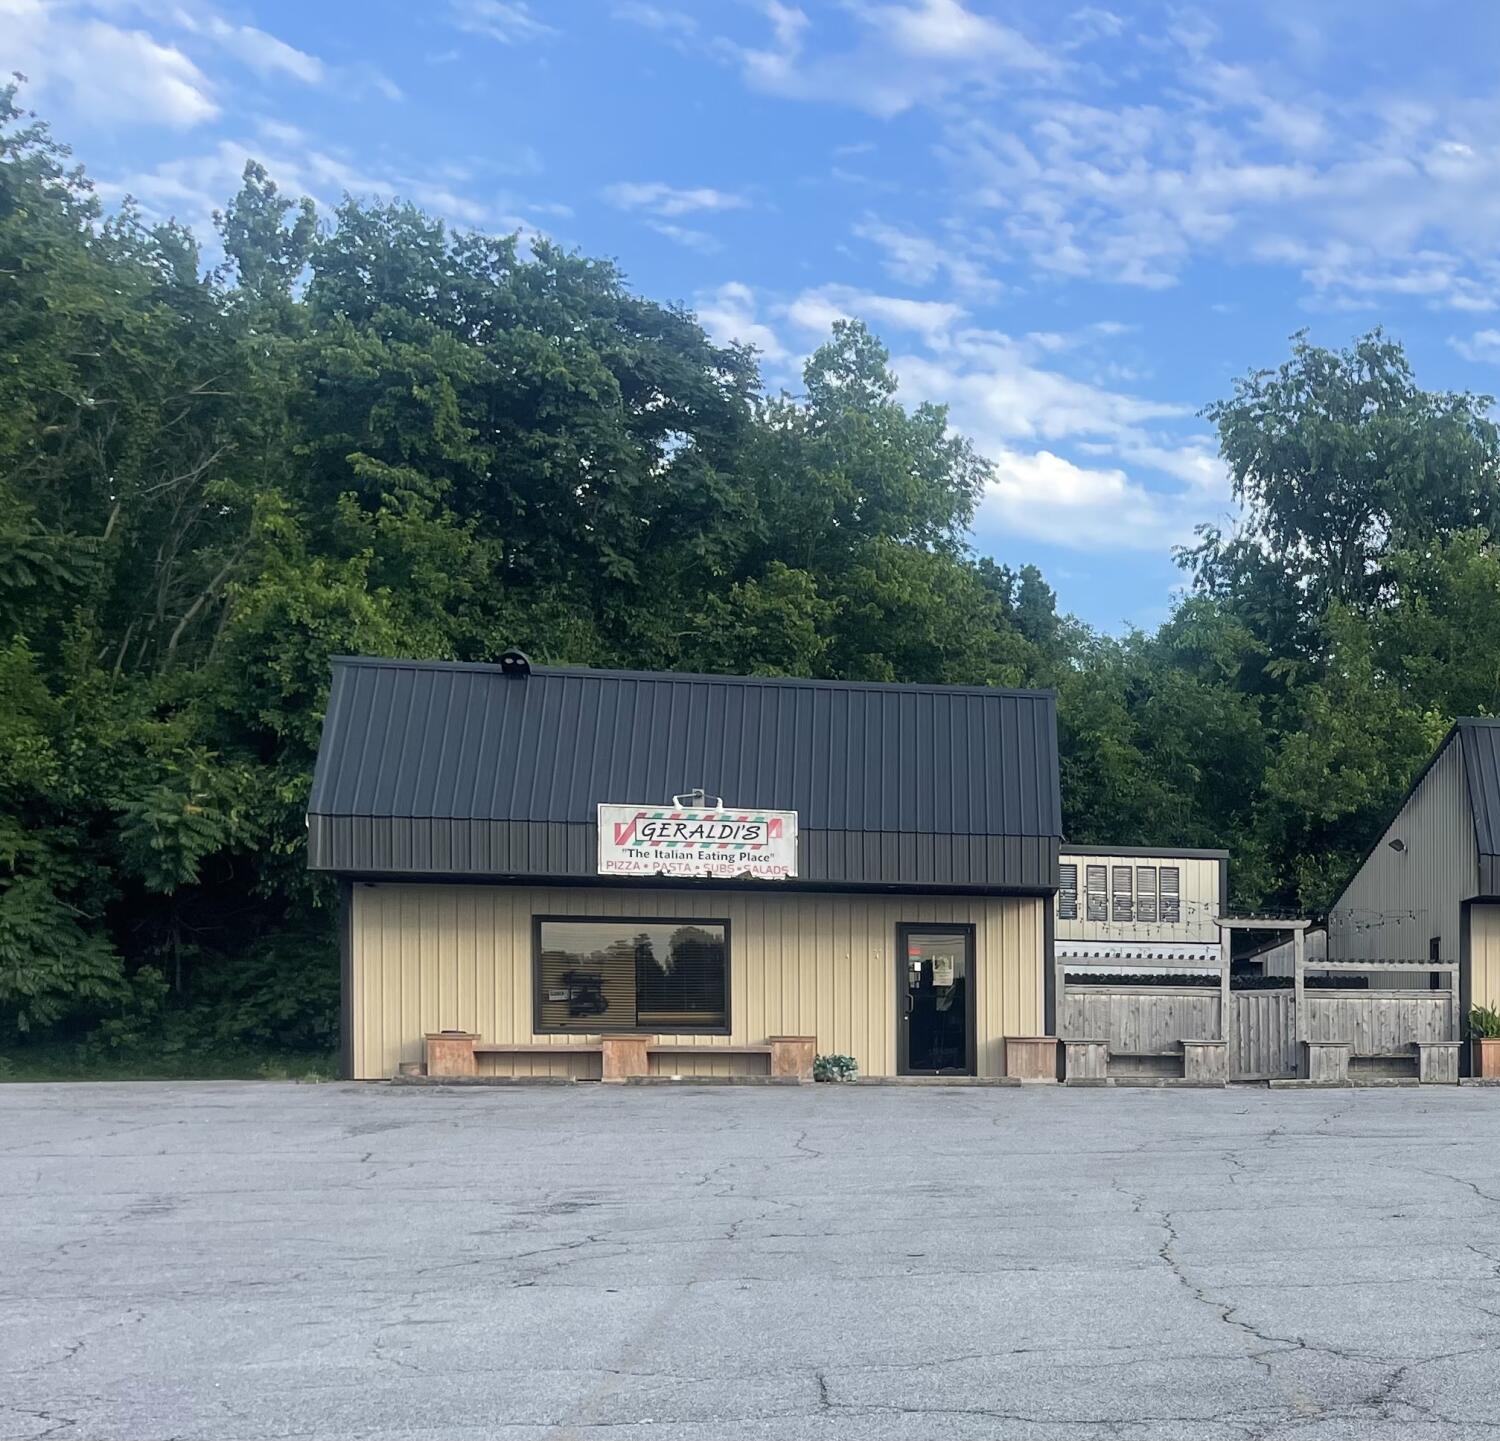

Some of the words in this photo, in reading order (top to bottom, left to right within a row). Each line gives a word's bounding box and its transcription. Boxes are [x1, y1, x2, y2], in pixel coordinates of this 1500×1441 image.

[641, 823, 760, 841] GERALDI'S
[622, 849, 650, 859] "The
[655, 849, 693, 860] Italian
[698, 851, 736, 863] Eating
[739, 853, 775, 862] Place"
[606, 861, 640, 870] PIZZA
[653, 862, 691, 873] PASTA
[704, 864, 735, 873] SUBS
